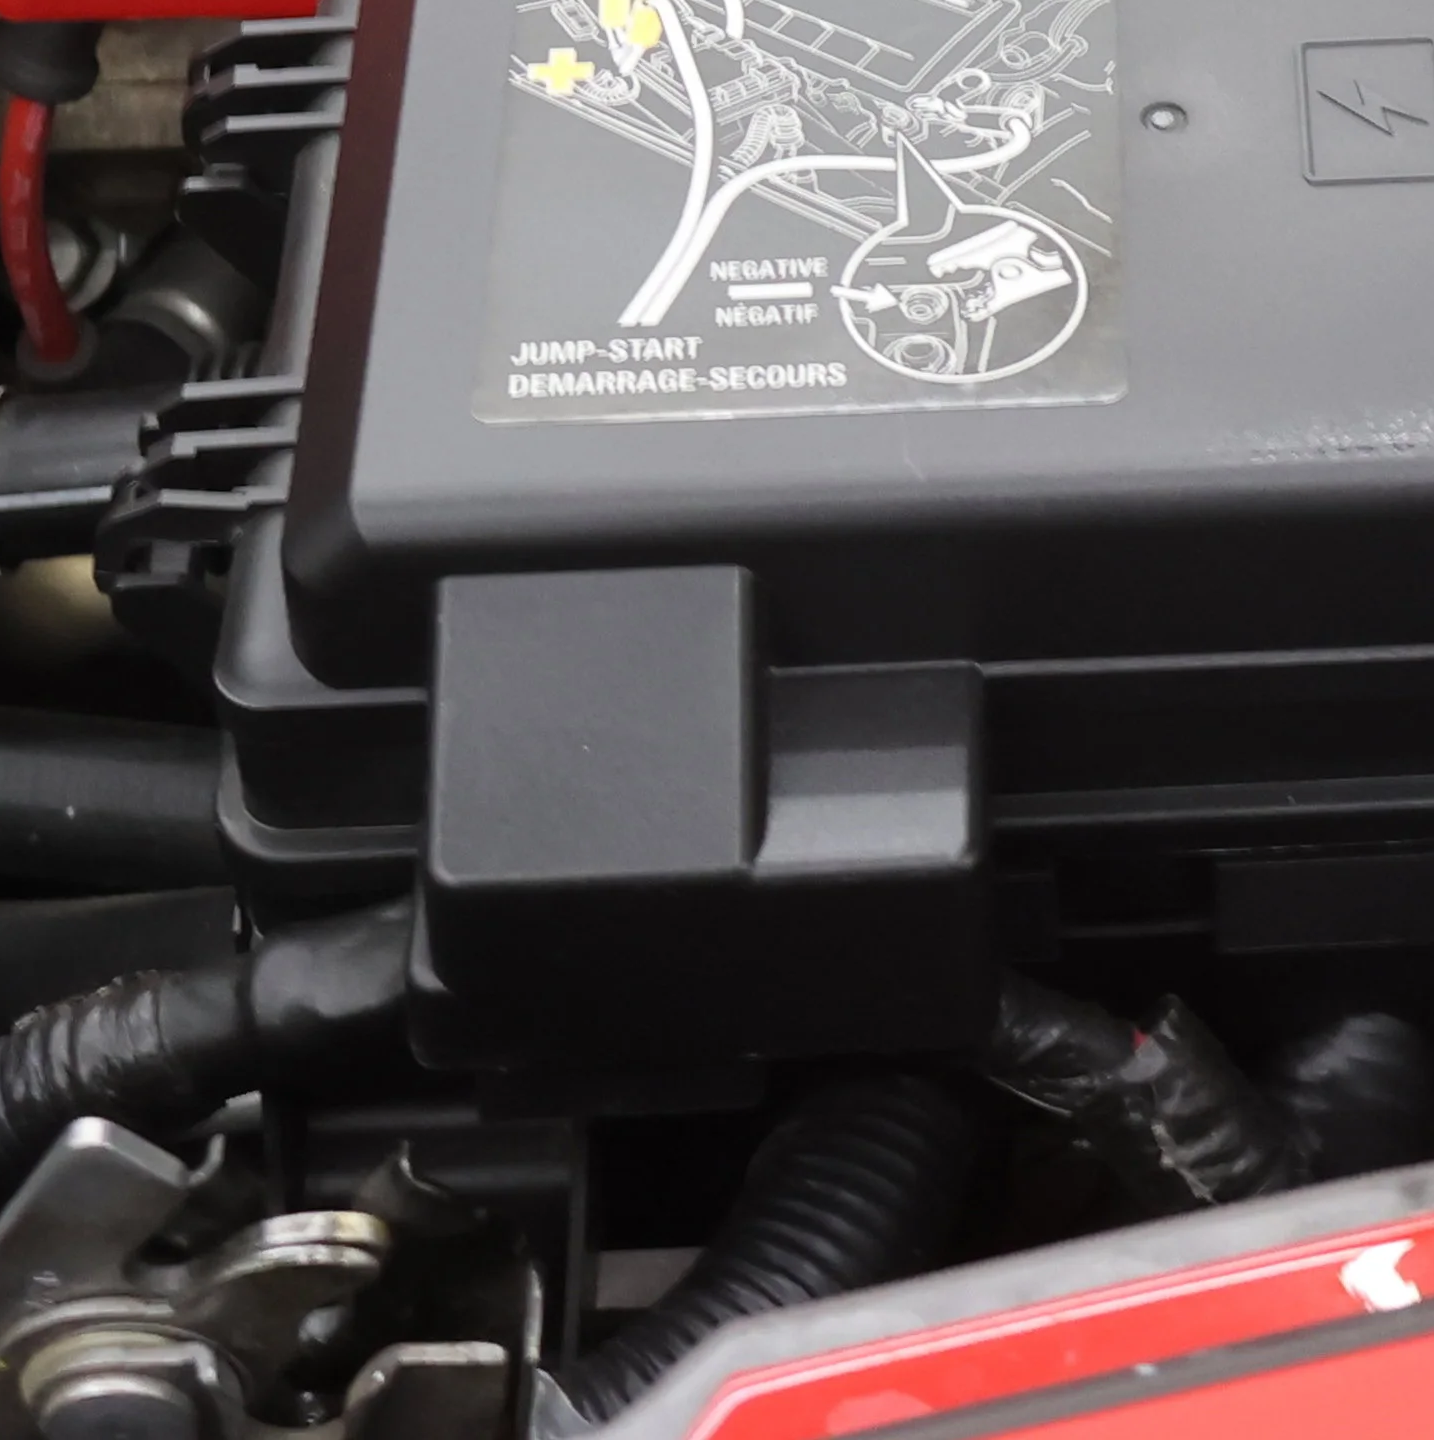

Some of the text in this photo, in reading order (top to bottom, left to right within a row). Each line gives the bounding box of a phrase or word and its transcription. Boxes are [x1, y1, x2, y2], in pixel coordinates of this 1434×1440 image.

[710, 257, 829, 282] NEGATIVE
[716, 302, 819, 328] NÉGATIF
[511, 336, 704, 367] JUMP-START
[507, 362, 849, 399] DEMARRAGE-SECOURS
